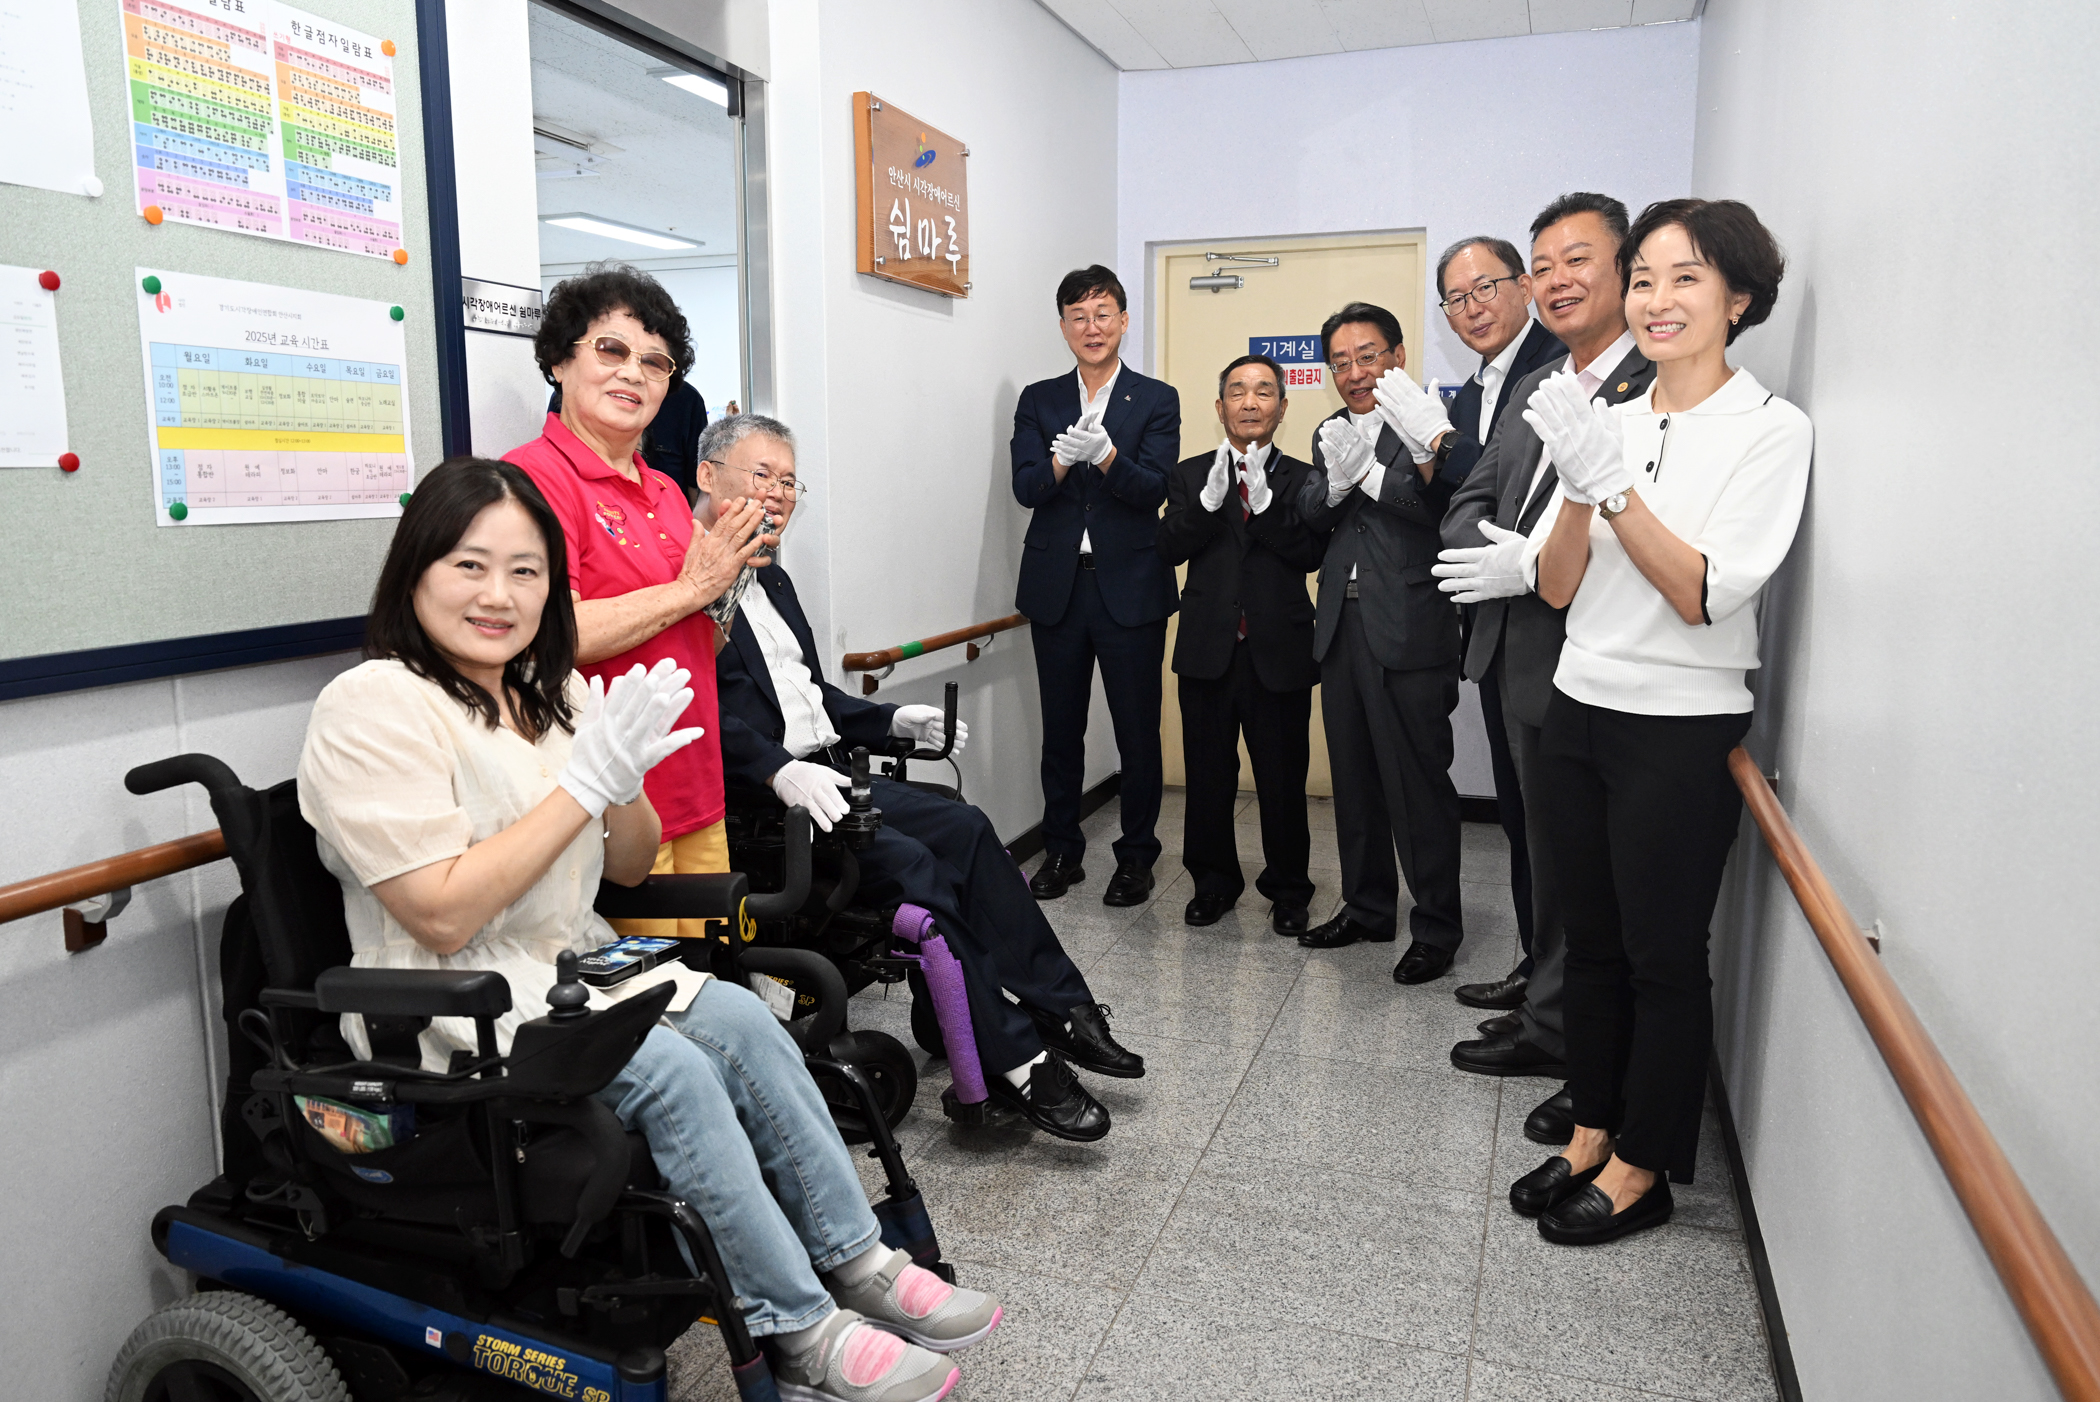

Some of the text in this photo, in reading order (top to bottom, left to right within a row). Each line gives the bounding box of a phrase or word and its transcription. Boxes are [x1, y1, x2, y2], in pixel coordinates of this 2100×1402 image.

[290, 20, 373, 58] 한글점자일람표
[888, 166, 960, 212] 안산시 시각장애어르신
[889, 197, 962, 275] 쉼마루
[463, 296, 541, 320] 시각장애어르신 쉼마루
[245, 330, 329, 350] 2025년 교육 시간표
[1261, 340, 1315, 360] 기계실
[184, 351, 210, 364] 월요일
[245, 357, 268, 369] 화요일
[306, 363, 326, 374] 수요일
[346, 366, 365, 377] 목요일
[376, 369, 394, 379] 금요일
[476, 1334, 566, 1370] STORM SERIES
[473, 1345, 578, 1398] TORQUE
